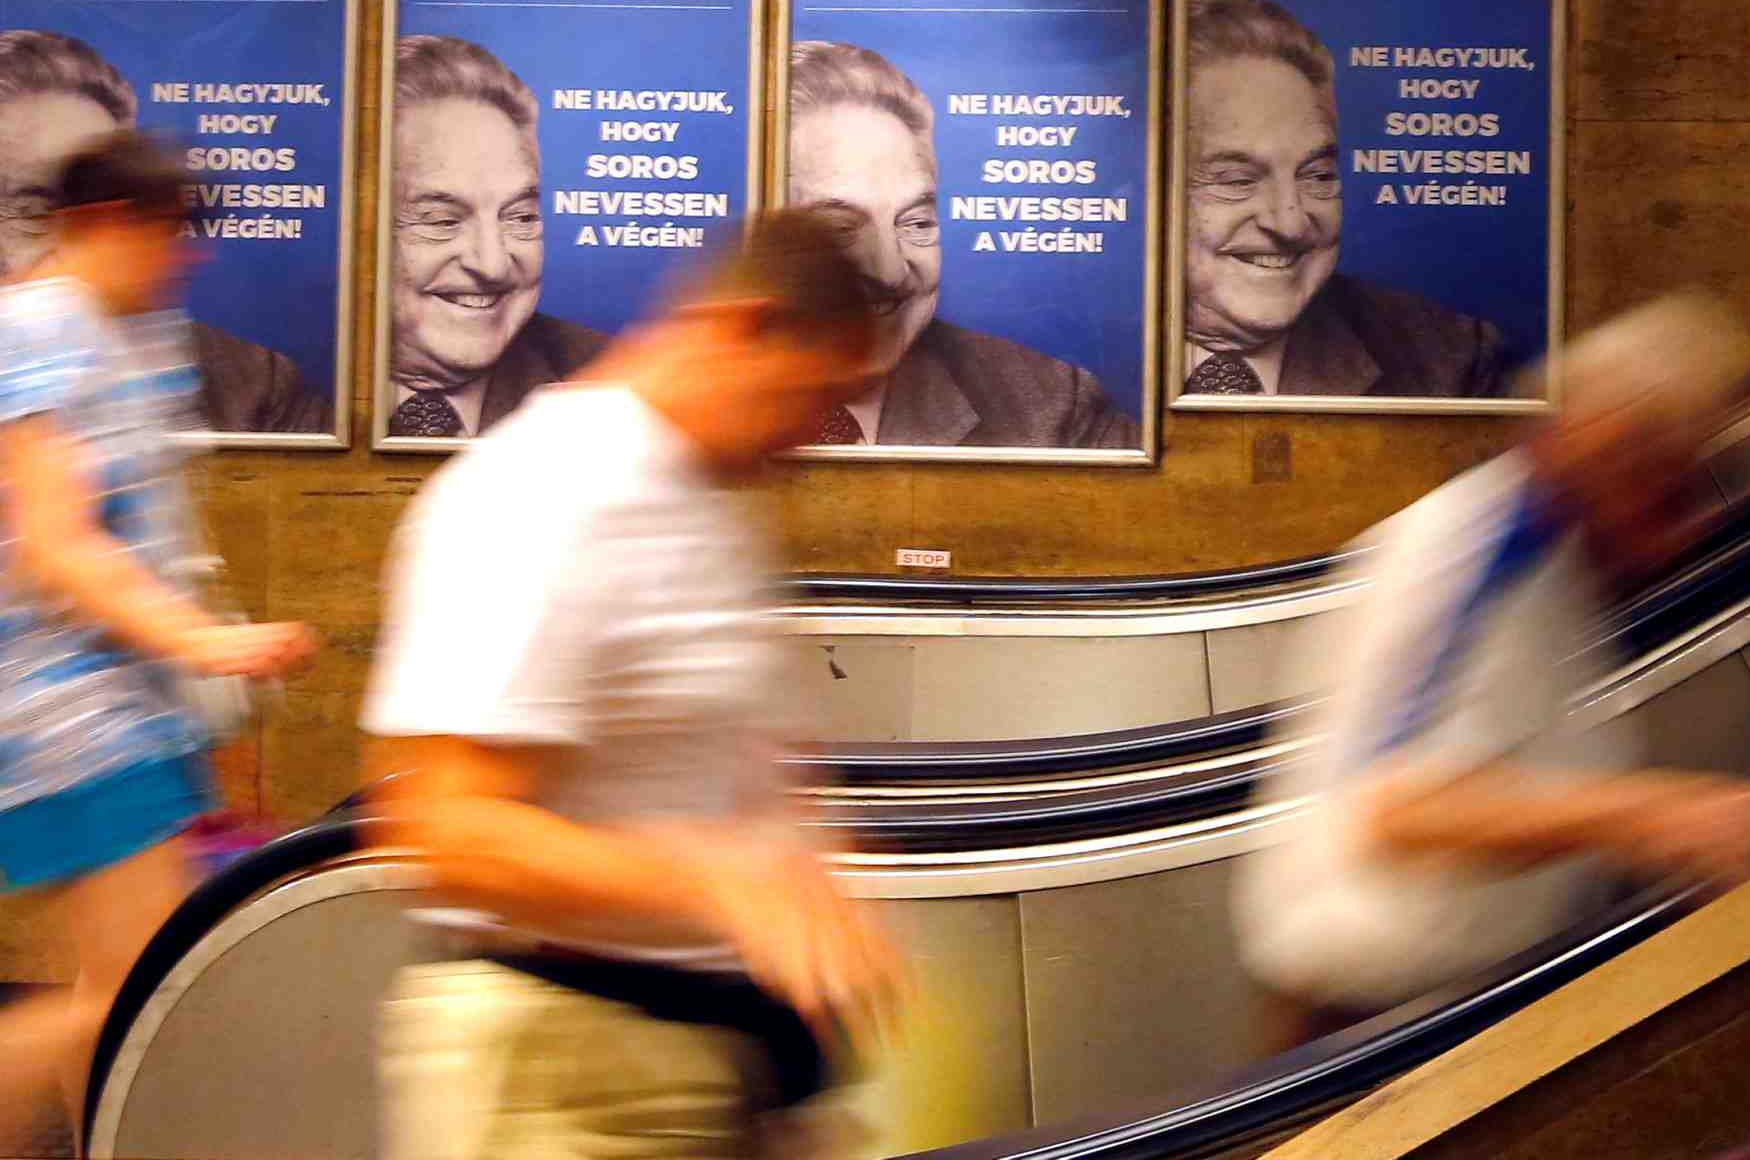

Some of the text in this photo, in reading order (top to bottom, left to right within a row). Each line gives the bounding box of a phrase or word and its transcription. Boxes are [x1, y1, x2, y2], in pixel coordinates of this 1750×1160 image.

[1351, 47, 1534, 70] NE HAGYJUK,
[152, 84, 330, 106] NE HAGYJUK,
[1399, 79, 1479, 98] HOGY
[554, 91, 733, 115] NE HAGYJUK,
[949, 95, 1131, 118] NE HAGYJUK,
[199, 115, 277, 134] HOGY
[602, 122, 679, 141] HOGY
[996, 126, 1075, 146] HOGY
[1385, 113, 1499, 136] SOROS
[186, 148, 295, 170] SOROS
[586, 155, 697, 179] SOROS
[1354, 150, 1530, 175] NEVESSEN
[982, 160, 1095, 183] SOROS
[181, 185, 324, 207] EVESSEN
[555, 192, 727, 216] NEVESSEN
[1377, 180, 1506, 206] A VÉGÉN!
[951, 197, 1126, 220] NEVESSEN
[202, 214, 302, 238] VÉGÉN!
[578, 221, 703, 248] A VÉGÉN!
[974, 226, 1102, 253] A VÉGÉN!
[903, 553, 945, 564] STOP
